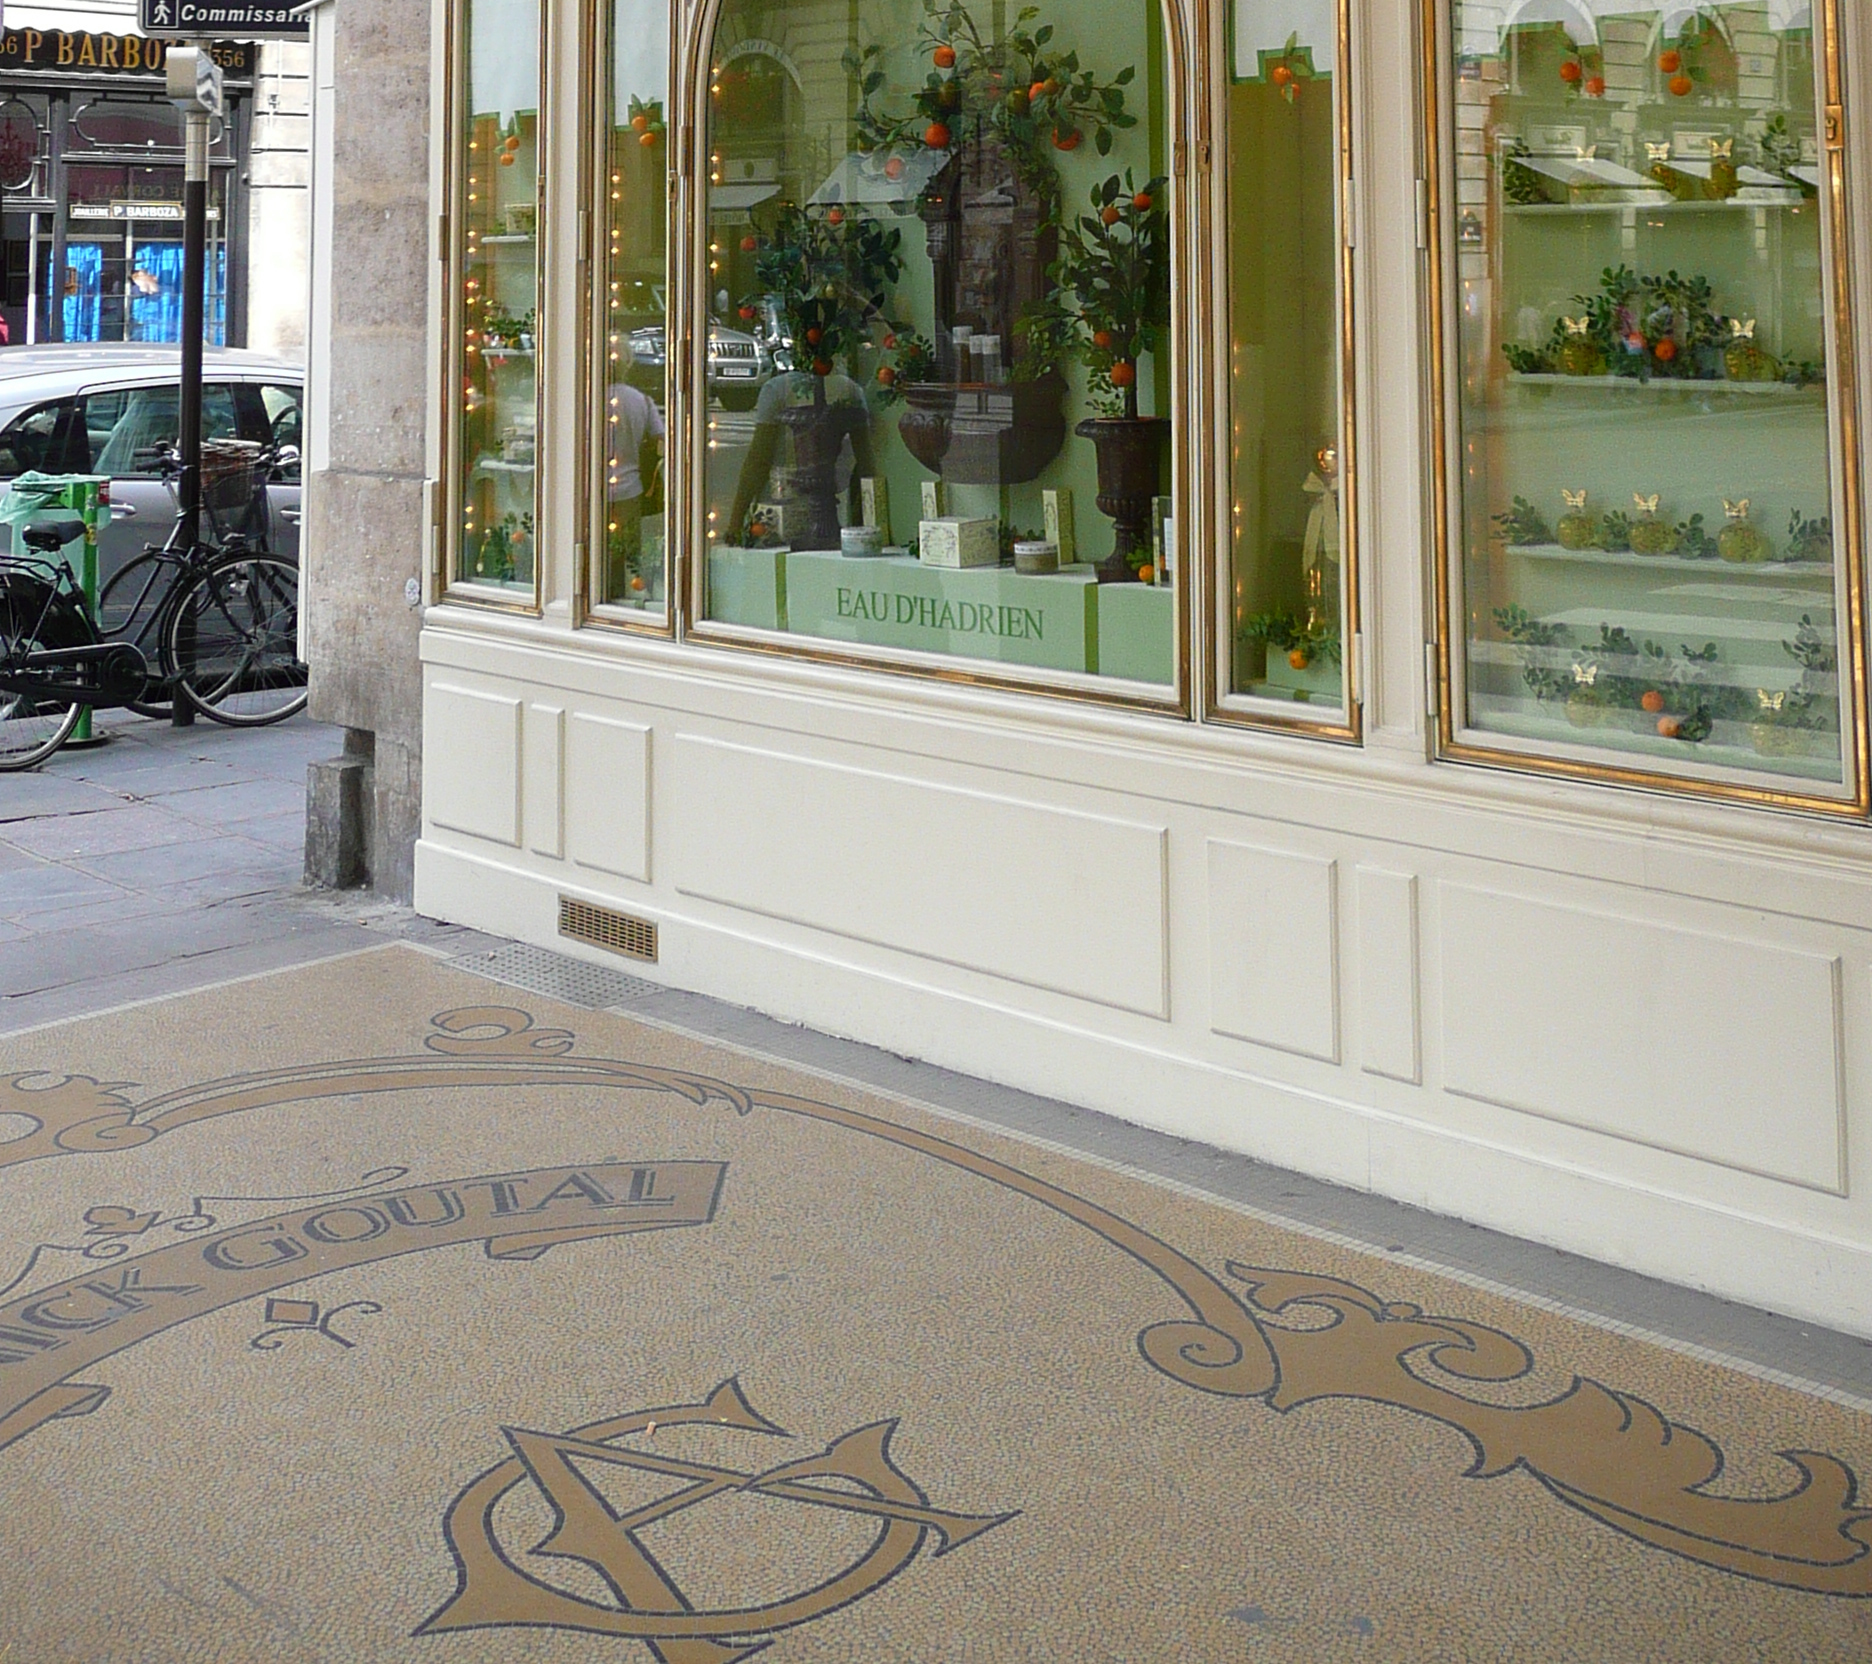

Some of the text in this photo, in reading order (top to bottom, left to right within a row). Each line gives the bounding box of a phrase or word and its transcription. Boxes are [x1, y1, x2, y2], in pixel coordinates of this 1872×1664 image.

[24, 30, 43, 63] P
[56, 32, 190, 71] BARBO
[211, 49, 245, 67] 356
[126, 206, 179, 218] BARBOZA
[836, 587, 1045, 641] EAU D'HADRIEN
[202, 1168, 676, 1272] GOUTAL
